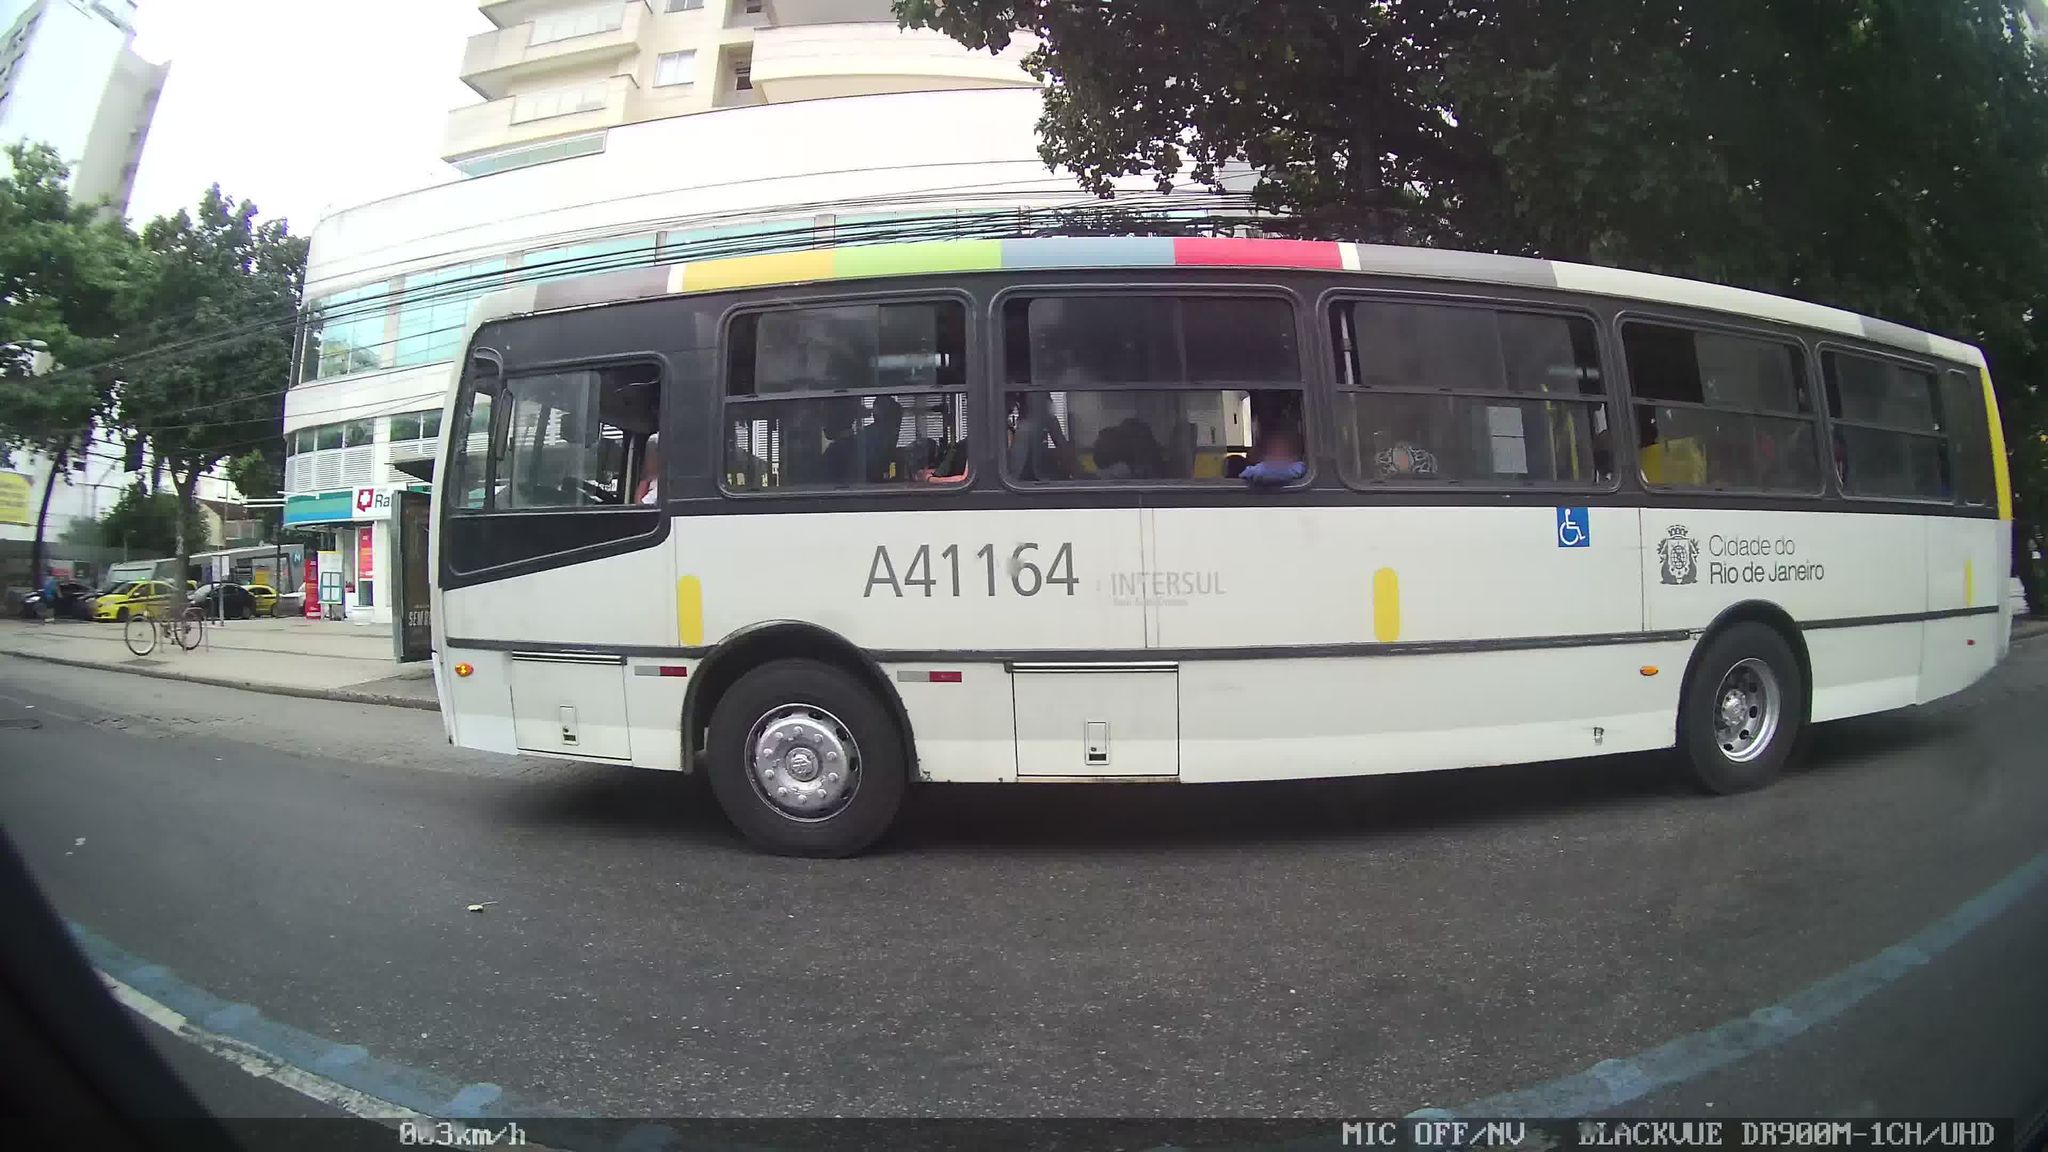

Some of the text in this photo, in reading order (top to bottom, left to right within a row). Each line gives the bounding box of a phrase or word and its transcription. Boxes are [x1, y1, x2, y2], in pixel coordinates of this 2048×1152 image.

[1709, 534, 1795, 557] Cidade do
[863, 542, 1080, 598] A41164
[1710, 559, 1825, 585] Rio de Janeiro
[1111, 571, 1227, 596] INTERSUL
